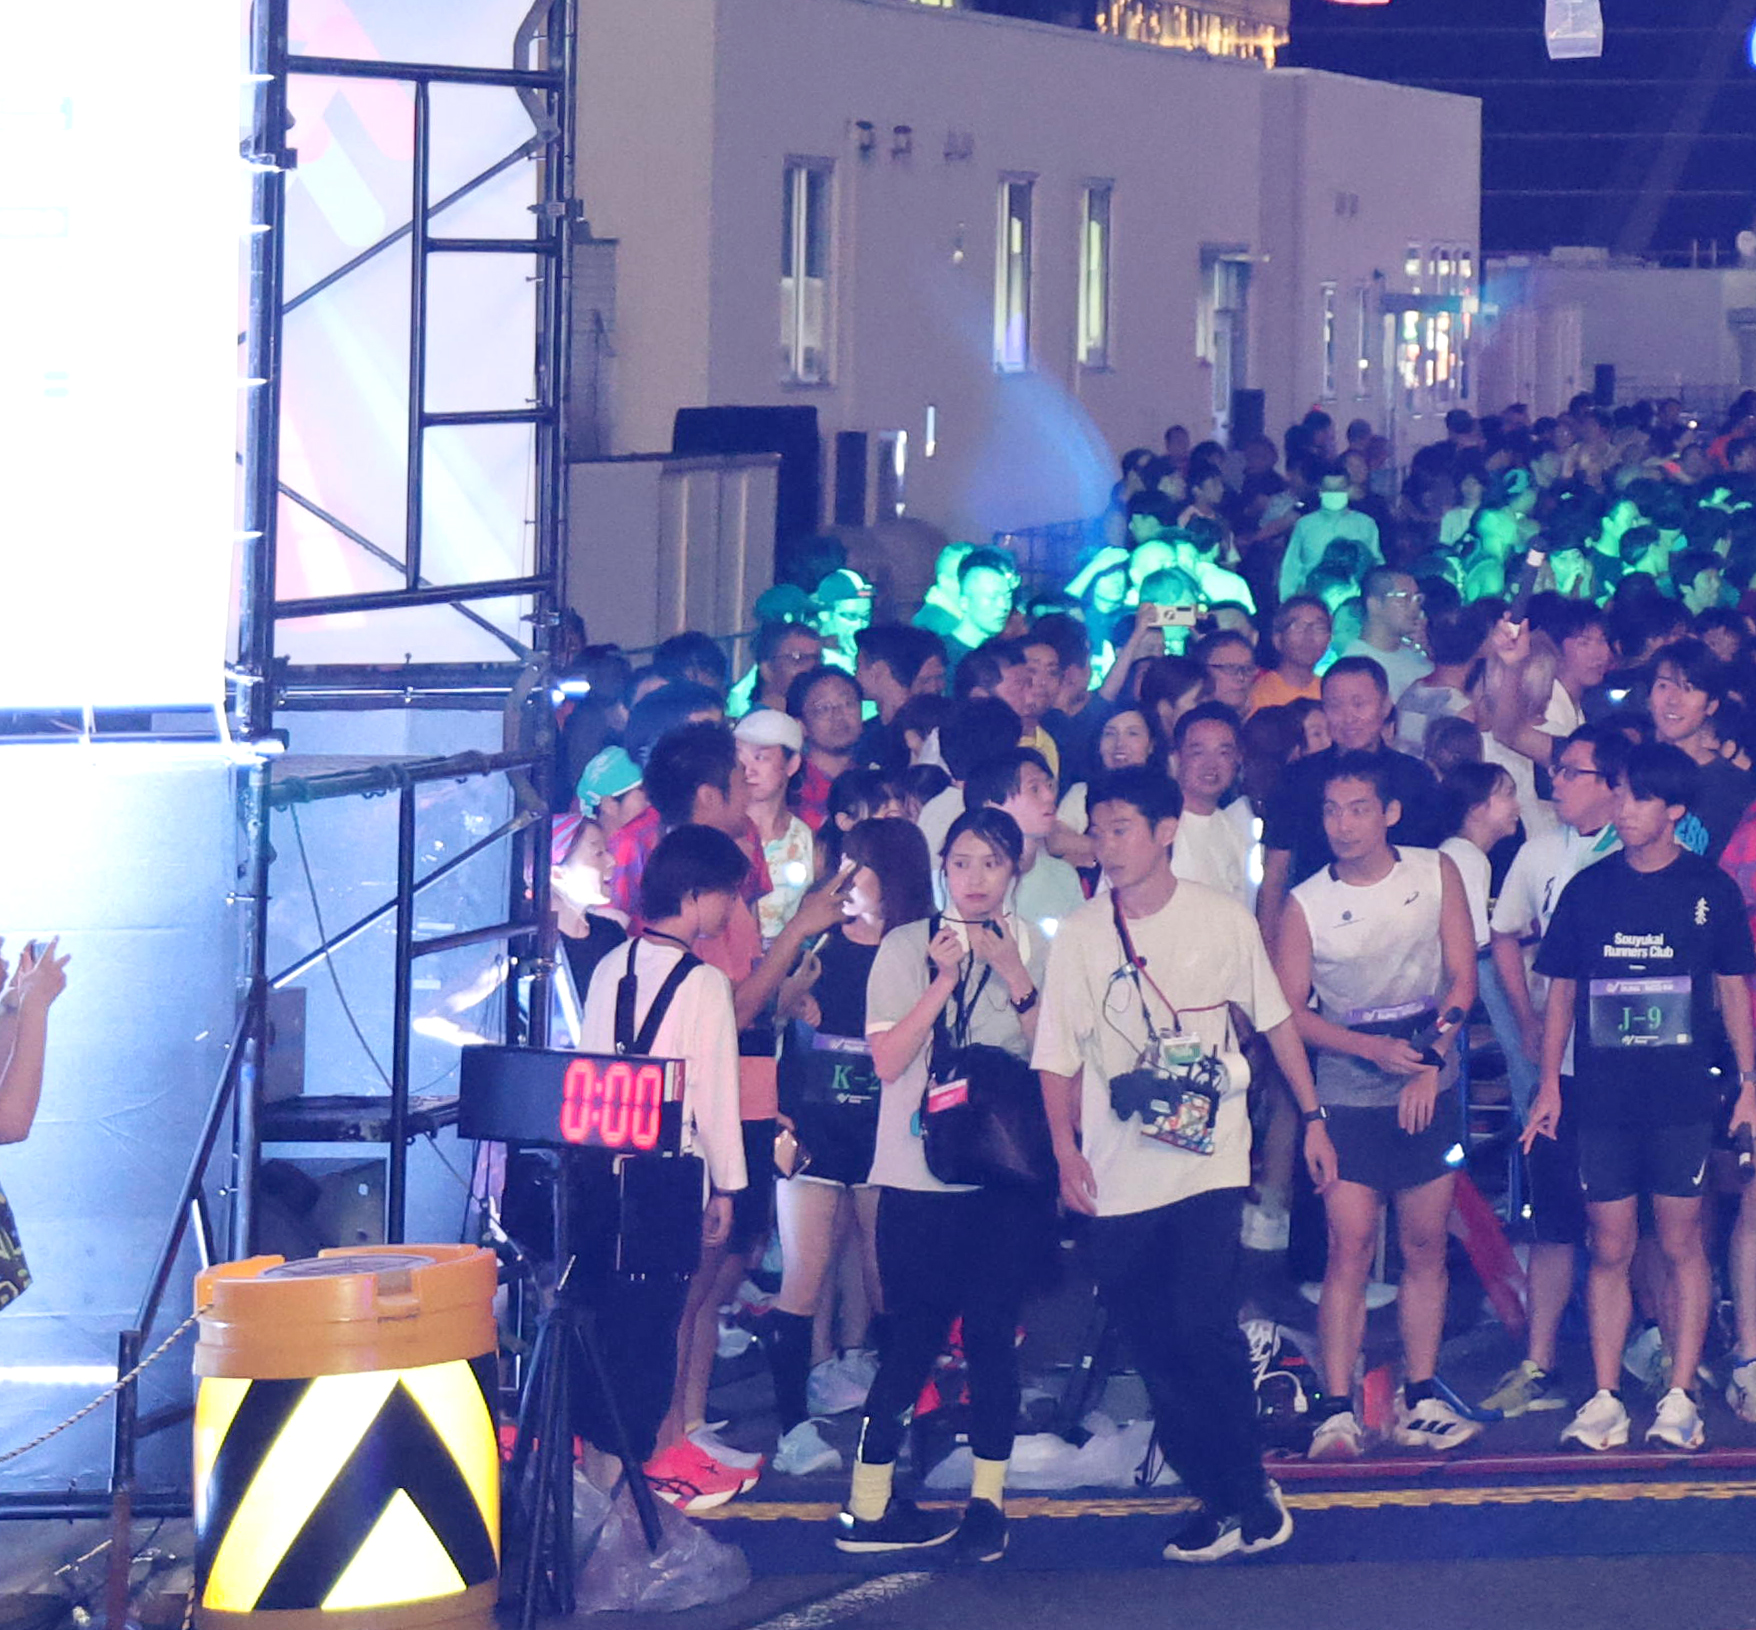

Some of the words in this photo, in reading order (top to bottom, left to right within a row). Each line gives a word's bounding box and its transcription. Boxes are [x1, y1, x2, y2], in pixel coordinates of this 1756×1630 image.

[1614, 931, 1664, 948] Souyukai
[1603, 944, 1649, 959] Runners
[1650, 944, 1674, 959] Club
[1617, 1005, 1662, 1032] J-9
[560, 1058, 664, 1150] 0:00
